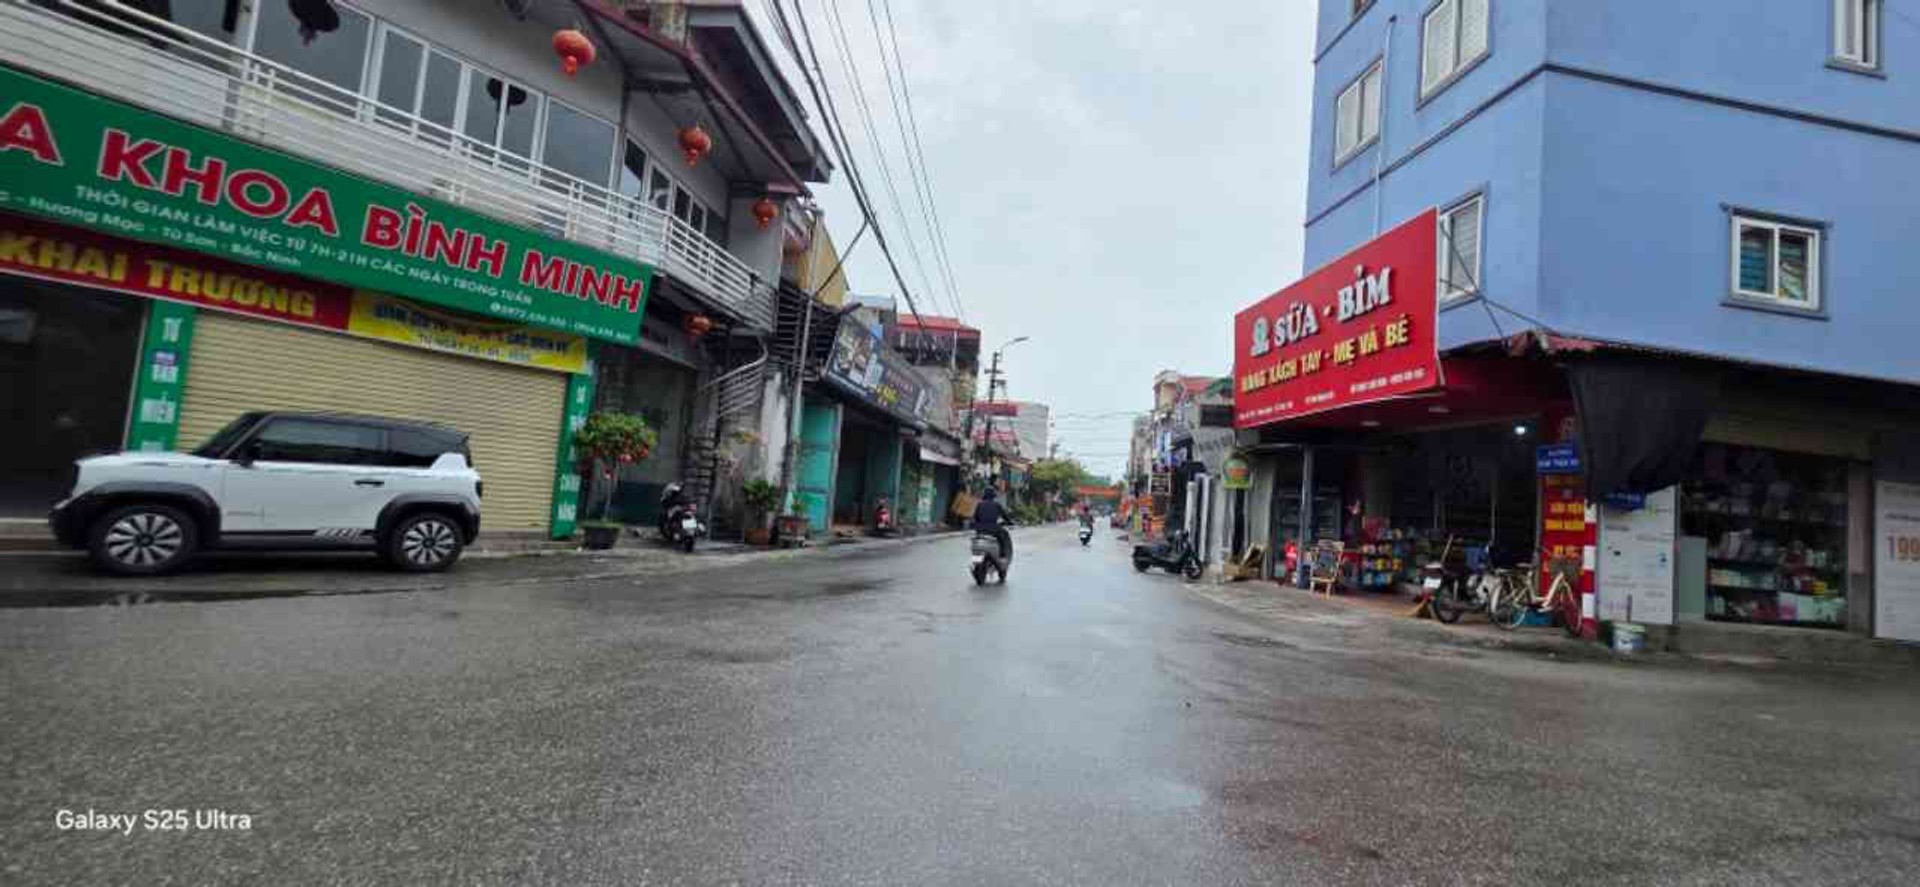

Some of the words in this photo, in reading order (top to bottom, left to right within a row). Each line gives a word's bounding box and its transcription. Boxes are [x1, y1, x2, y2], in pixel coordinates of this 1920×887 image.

[29, 196, 98, 224] Hương
[101, 213, 145, 233] Mạc
[265, 250, 302, 267] Ninh
[74, 185, 129, 208] THỜI
[132, 199, 189, 223] GIAN
[193, 212, 236, 234] LÀM
[240, 224, 283, 246] VIỆC
[370, 256, 405, 276] CÁC
[408, 266, 450, 286] NGÀY
[454, 277, 498, 297] TRONG
[97, 127, 341, 238] KHOA
[362, 203, 506, 279] BÌNH
[520, 249, 643, 313] MINH
[0, 231, 128, 282] KHAI
[145, 258, 316, 319] TRƯƠNG
[1273, 299, 1319, 347] SỮA
[1338, 264, 1393, 322] BỈM
[1268, 356, 1297, 386] XÁCH
[1301, 349, 1322, 374] TAY
[1333, 338, 1357, 366] MẸ
[1358, 326, 1379, 354] VÀ
[1384, 314, 1410, 347] BÉ
